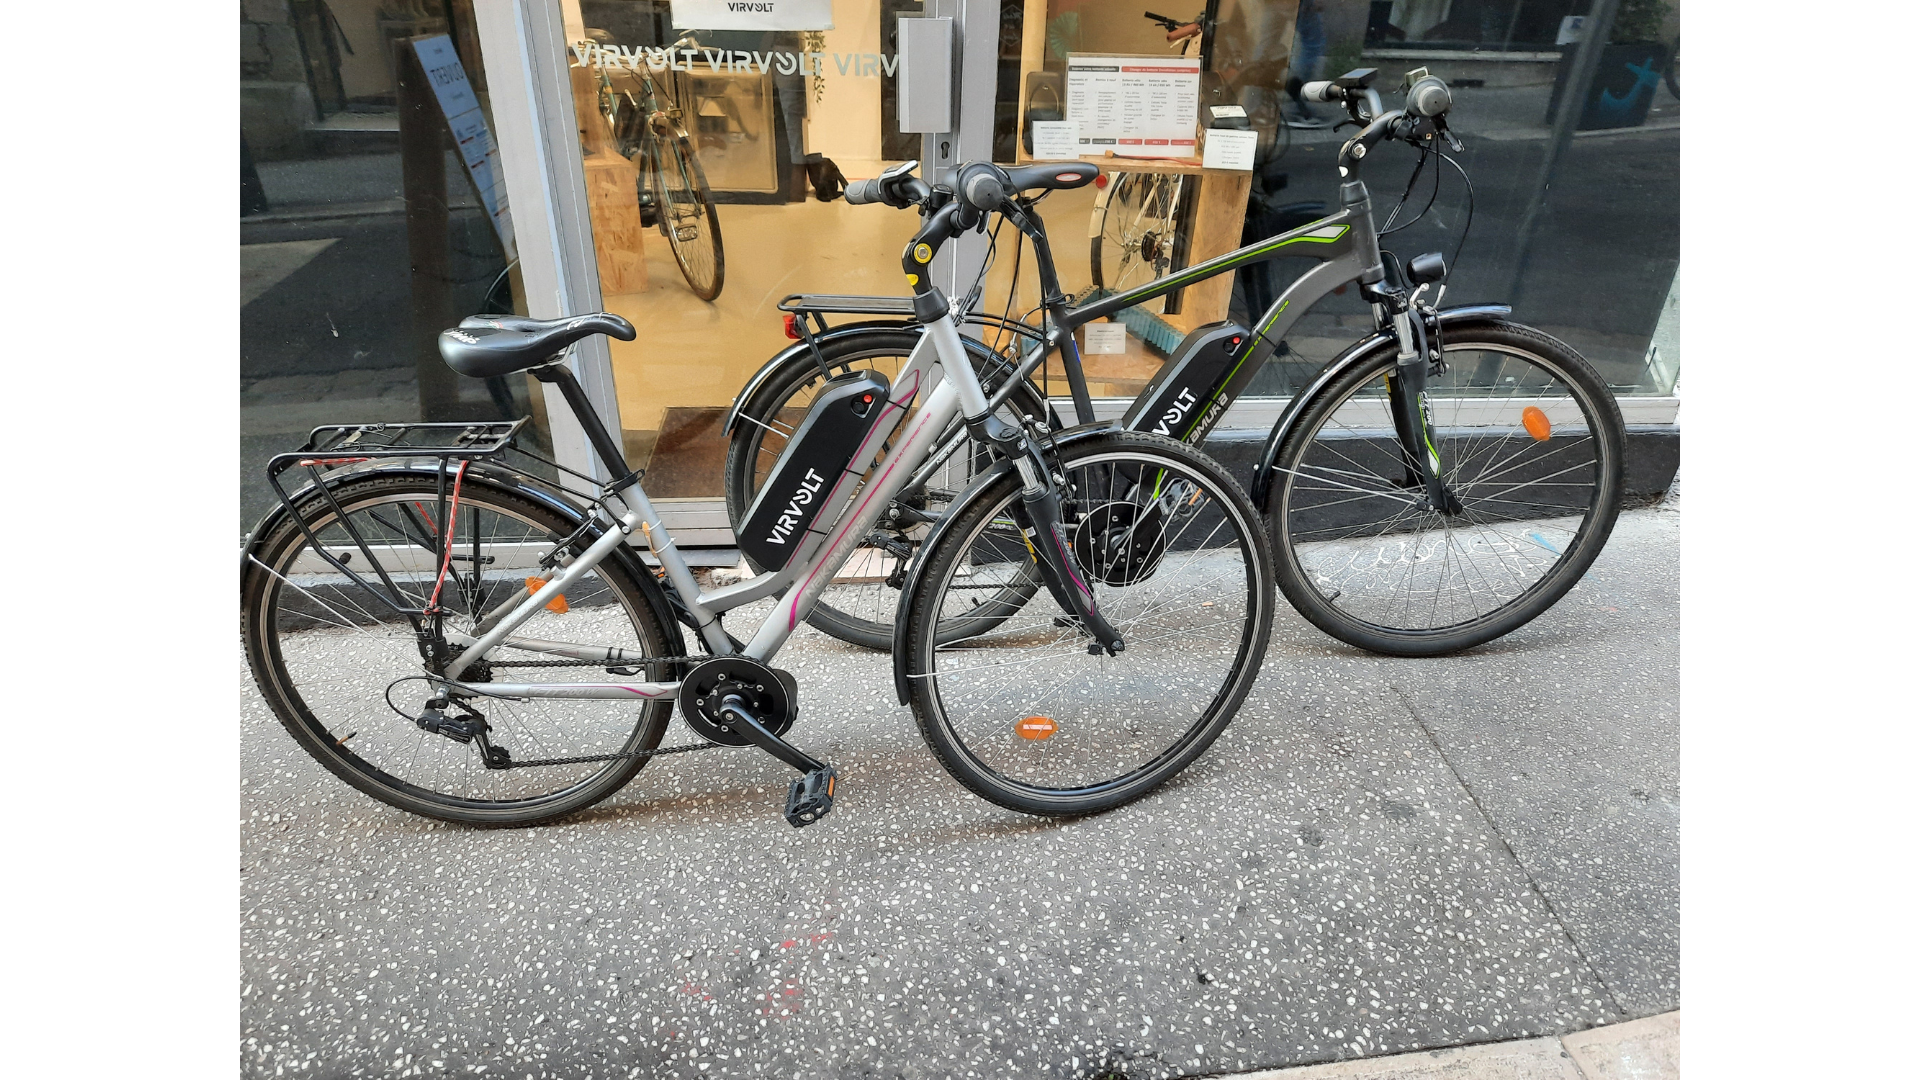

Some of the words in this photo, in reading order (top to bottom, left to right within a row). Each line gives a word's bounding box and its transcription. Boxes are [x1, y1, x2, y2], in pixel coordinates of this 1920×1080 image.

[728, 2, 774, 13] VIRVOLT
[571, 43, 698, 71] VIRVOLT
[704, 49, 825, 76] VIRVOLT
[766, 467, 825, 546] VIRVOLT
